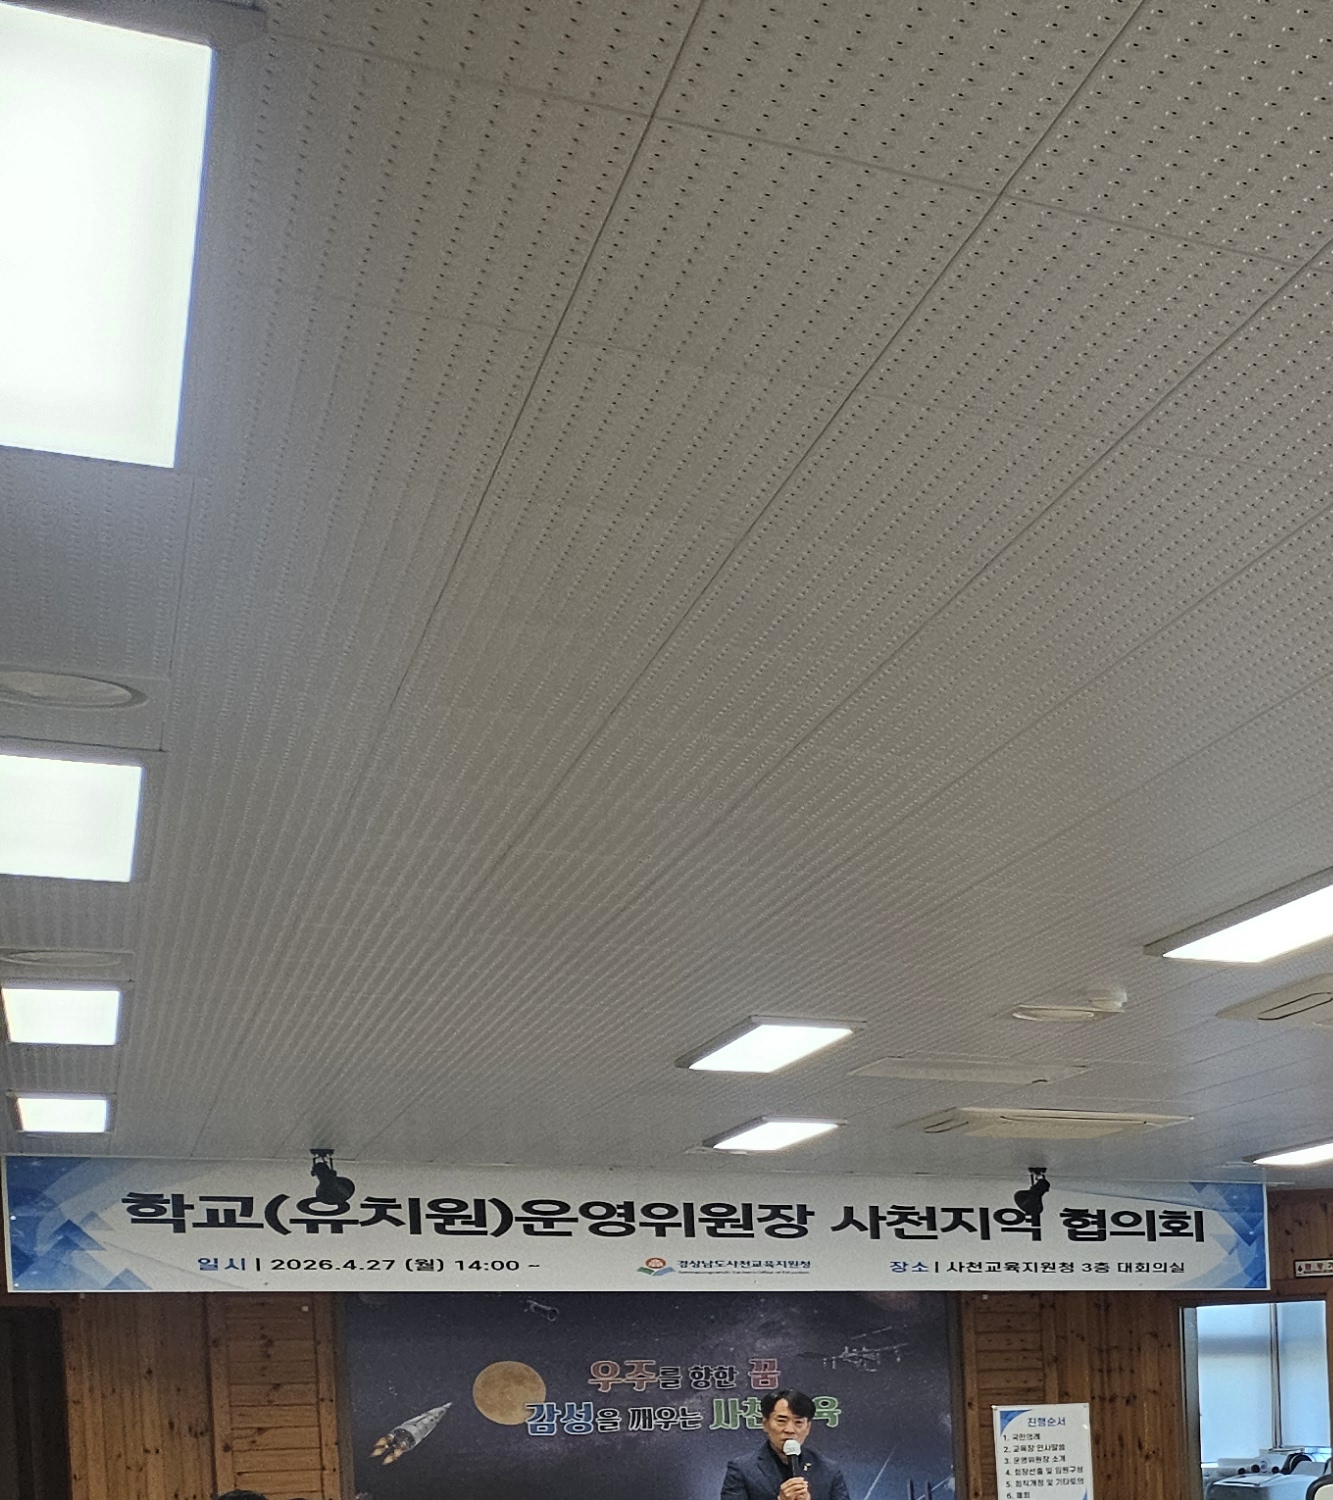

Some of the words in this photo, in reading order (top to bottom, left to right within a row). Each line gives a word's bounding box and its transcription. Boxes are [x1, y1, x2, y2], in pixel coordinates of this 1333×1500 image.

[121, 1191, 816, 1240] 학교(유치원)운영위원장
[831, 1204, 1041, 1241] 사천지역
[1060, 1207, 1205, 1242] 협의회
[270, 1258, 396, 1271] 2026.4.27
[405, 1257, 444, 1272] (월)
[455, 1259, 520, 1271] 14:00
[946, 1261, 1075, 1274] 사천교육지원청
[1081, 1262, 1110, 1274] 3층
[1117, 1262, 1186, 1274] 대회의실
[588, 1358, 682, 1393] 우주를
[688, 1365, 738, 1390] 향한
[748, 1358, 782, 1390] 꿈
[524, 1401, 621, 1436] 감성을
[628, 1406, 703, 1431] 깨우는
[709, 1394, 842, 1431] 사천육
[1027, 1416, 1066, 1428] 진행순서
